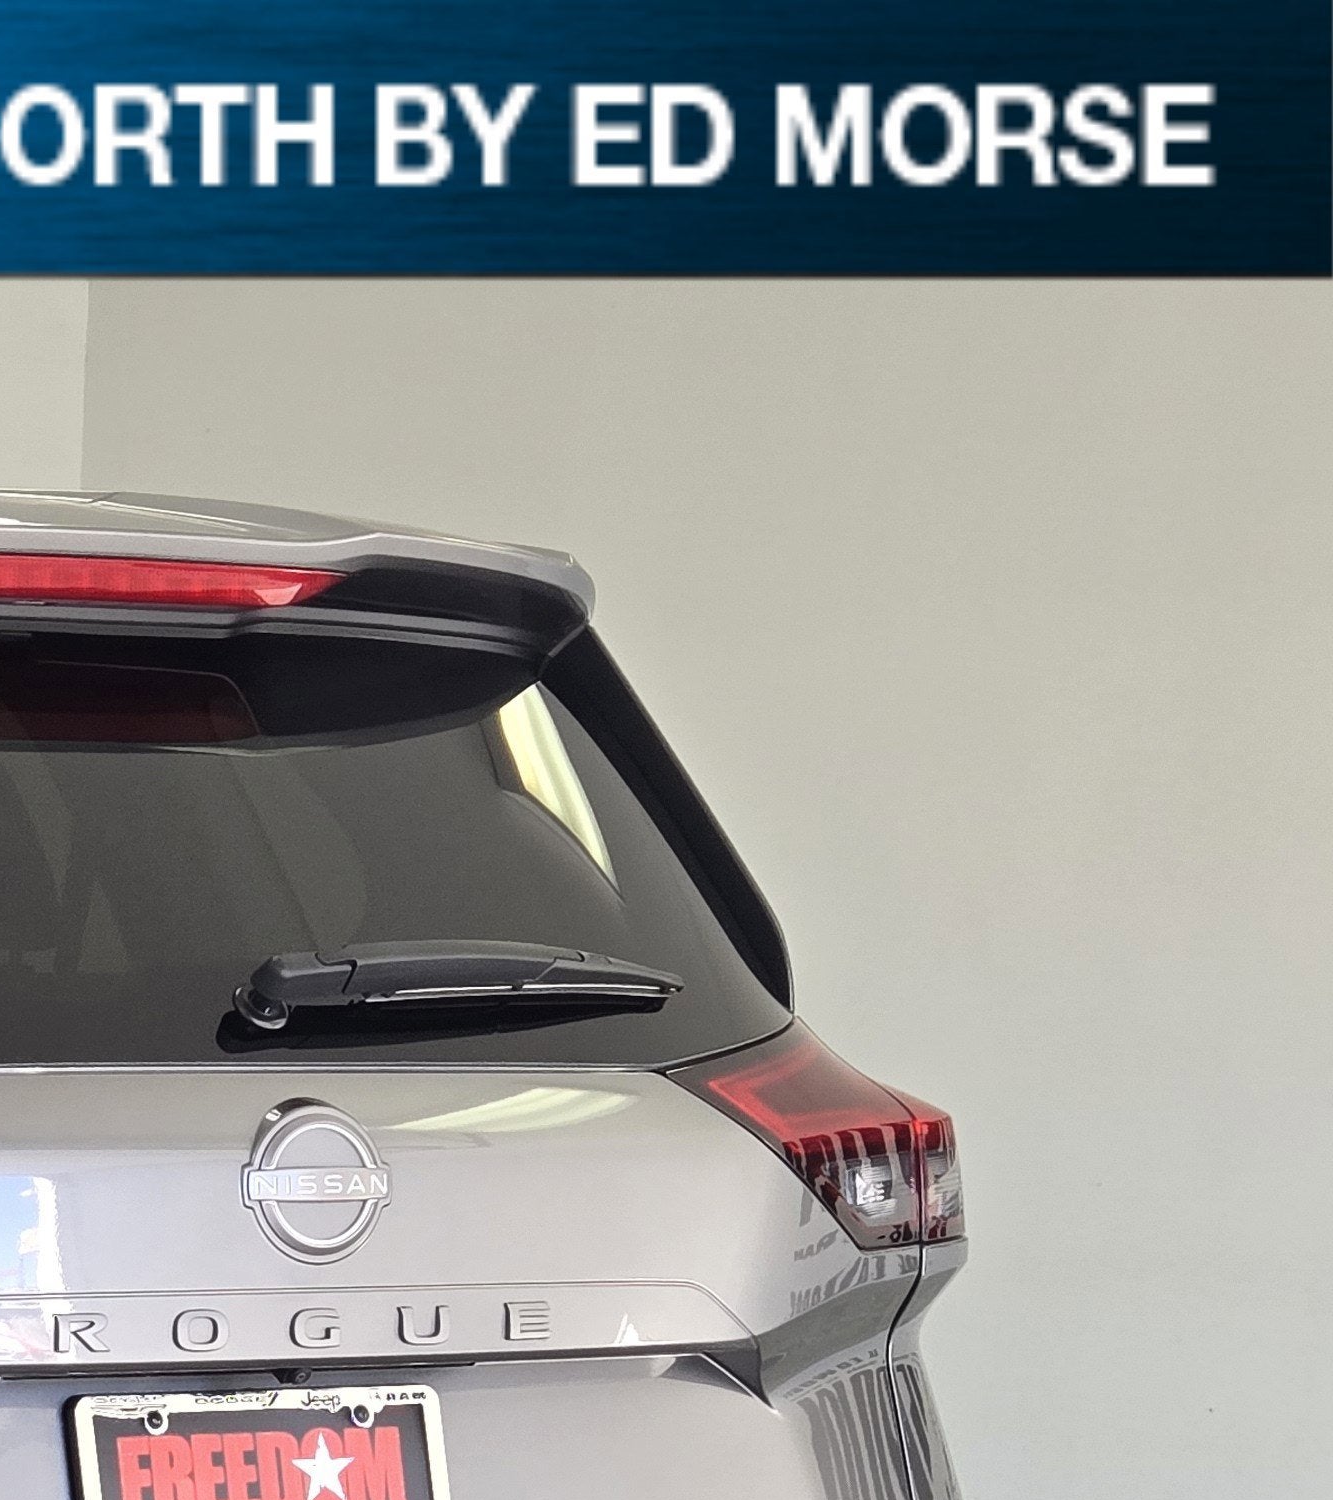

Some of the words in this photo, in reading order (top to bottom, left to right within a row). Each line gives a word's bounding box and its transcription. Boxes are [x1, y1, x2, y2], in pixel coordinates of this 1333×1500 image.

[253, 1173, 388, 1195] NISSAN
[51, 1300, 552, 1353] ROGUE
[301, 1391, 340, 1412] Jeep
